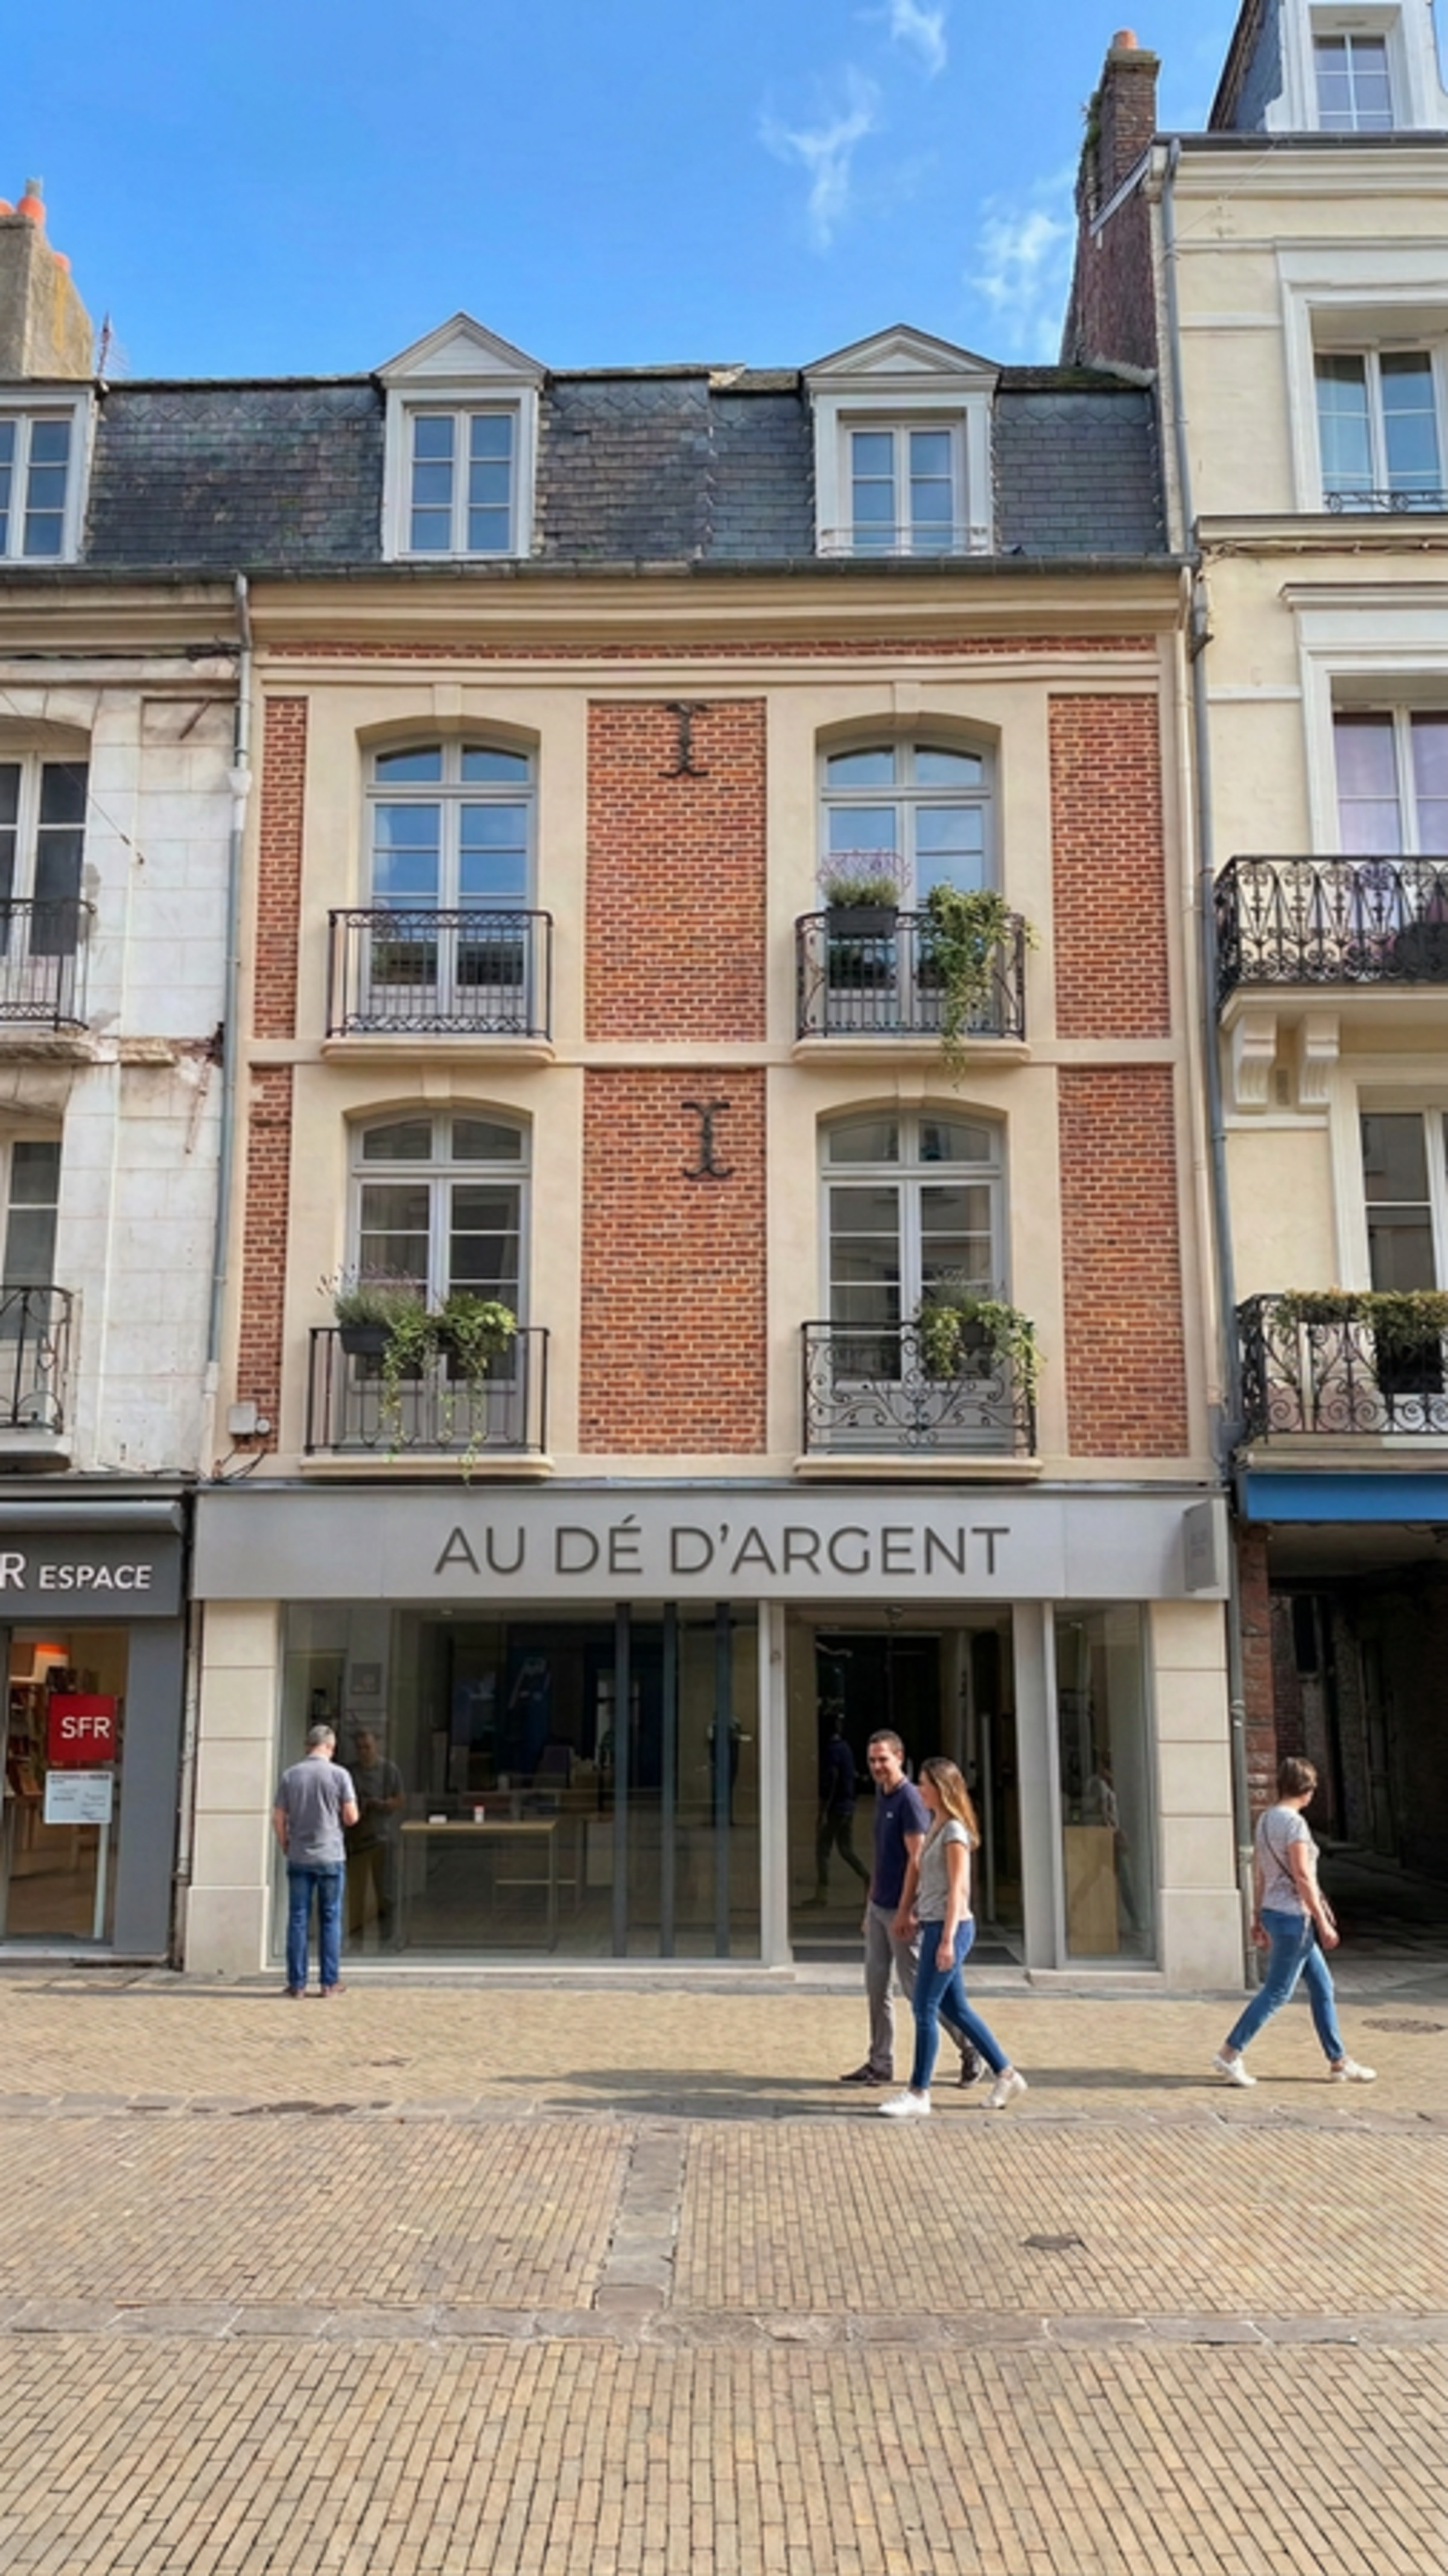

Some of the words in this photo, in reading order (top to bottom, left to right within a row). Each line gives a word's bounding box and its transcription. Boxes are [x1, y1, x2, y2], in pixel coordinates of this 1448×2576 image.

[434, 1526, 525, 1575] AU
[555, 1513, 643, 1575] DÉ
[670, 1523, 1011, 1575] D’ARGENT
[39, 1565, 152, 1589] ESPACE
[62, 1716, 111, 1739] SFR
